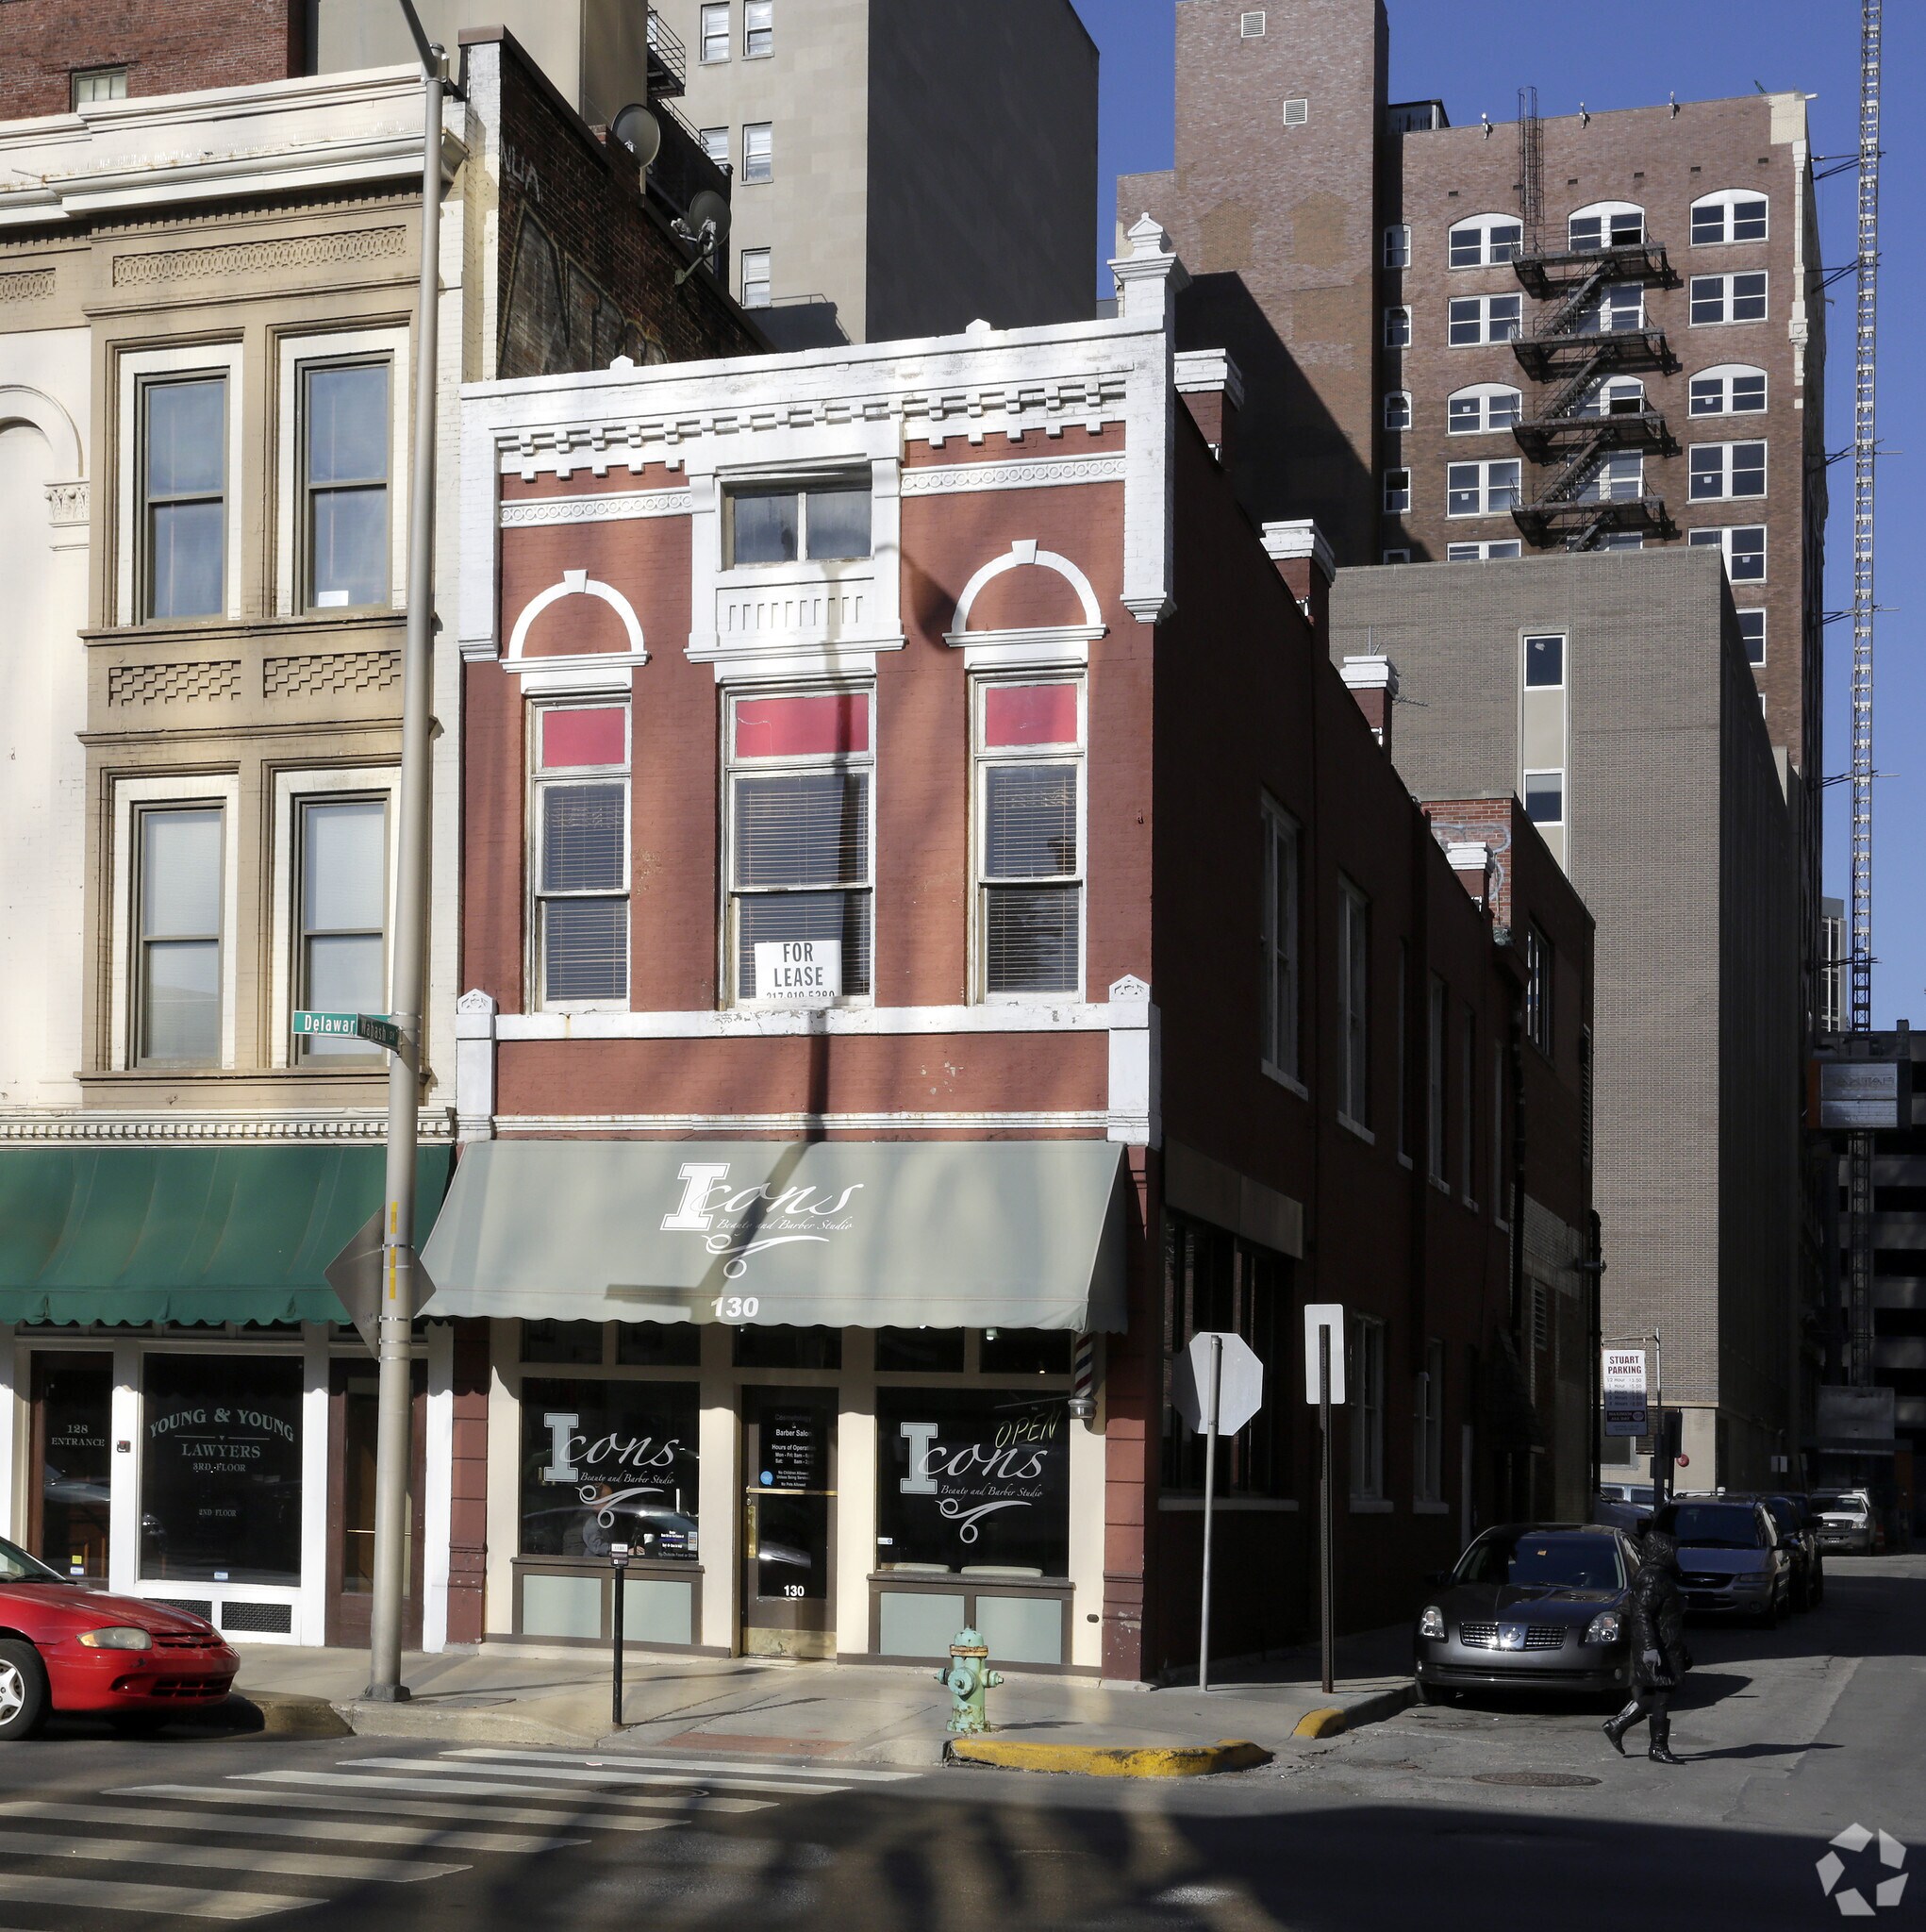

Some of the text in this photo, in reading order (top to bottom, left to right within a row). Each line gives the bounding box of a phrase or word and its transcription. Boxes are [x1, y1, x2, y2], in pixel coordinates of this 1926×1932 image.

[783, 942, 813, 962] FOR
[774, 966, 823, 987] LEASE
[304, 1014, 356, 1033] Delawar
[360, 1018, 387, 1041] Wabash
[660, 1162, 865, 1231] Icons
[717, 1216, 854, 1236] Beauty and Barber Studio
[710, 1296, 759, 1317] 130
[1609, 1356, 1639, 1364] STUART
[1608, 1366, 1641, 1374] PARKING
[67, 1424, 89, 1434] 128
[150, 1407, 294, 1442] YOUNG & YOUNG
[775, 1428, 795, 1437] Barber
[995, 1410, 1062, 1448] OPEN
[51, 1437, 105, 1447] ENTRANCE
[181, 1443, 261, 1458] LAWYERS
[544, 1412, 680, 1483] Icons
[192, 1462, 246, 1472] 3RD FLOOR
[900, 1422, 1049, 1494] Icons
[580, 1470, 674, 1488] Beauty and Barber Studio
[940, 1482, 1043, 1501] Beauty and Barber Studio
[784, 1585, 805, 1596] 130
